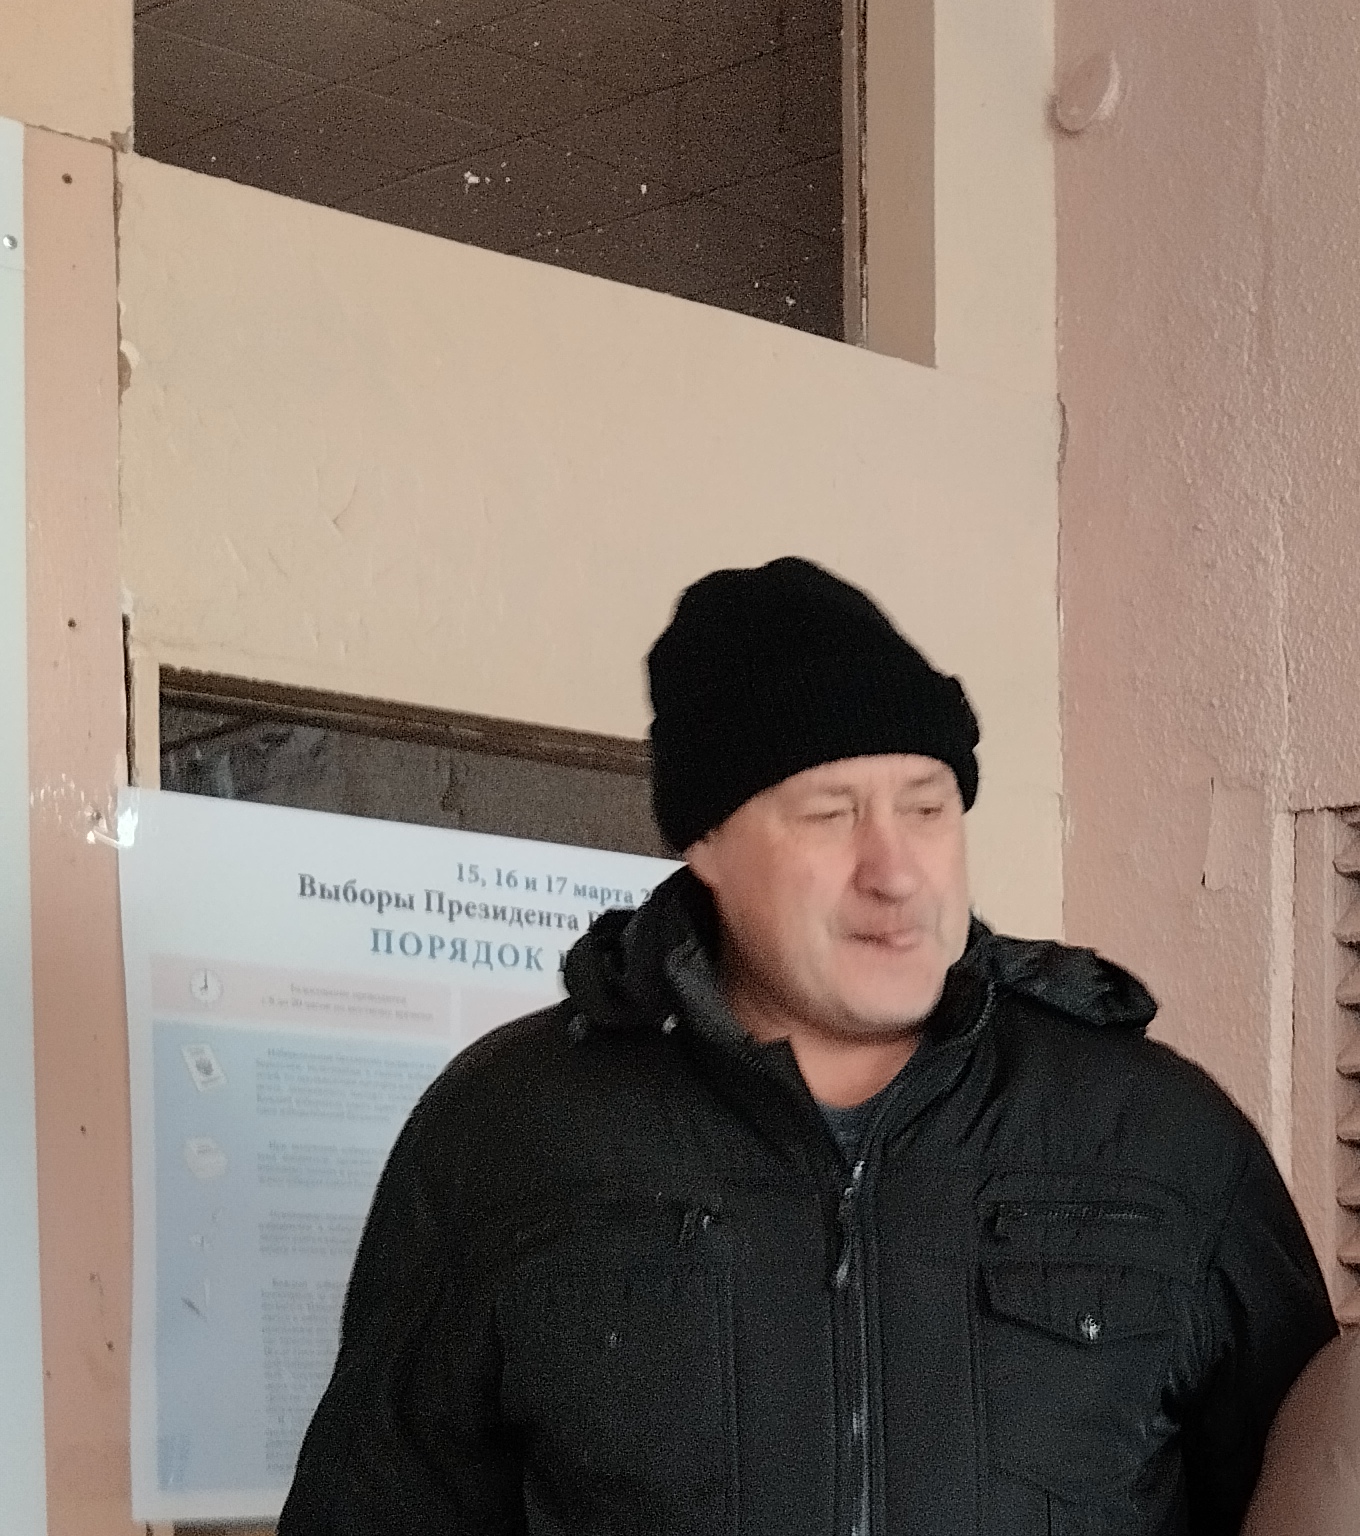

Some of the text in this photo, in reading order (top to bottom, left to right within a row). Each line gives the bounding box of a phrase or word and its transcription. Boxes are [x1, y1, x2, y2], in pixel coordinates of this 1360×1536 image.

[299, 873, 417, 915] Выборы
[424, 889, 580, 933] Президента
[457, 862, 488, 887] 15,
[495, 868, 519, 889] 16
[525, 876, 538, 892] и
[546, 875, 568, 895] 17
[574, 880, 635, 907] марта
[370, 928, 545, 972] ПОРЯДОК
